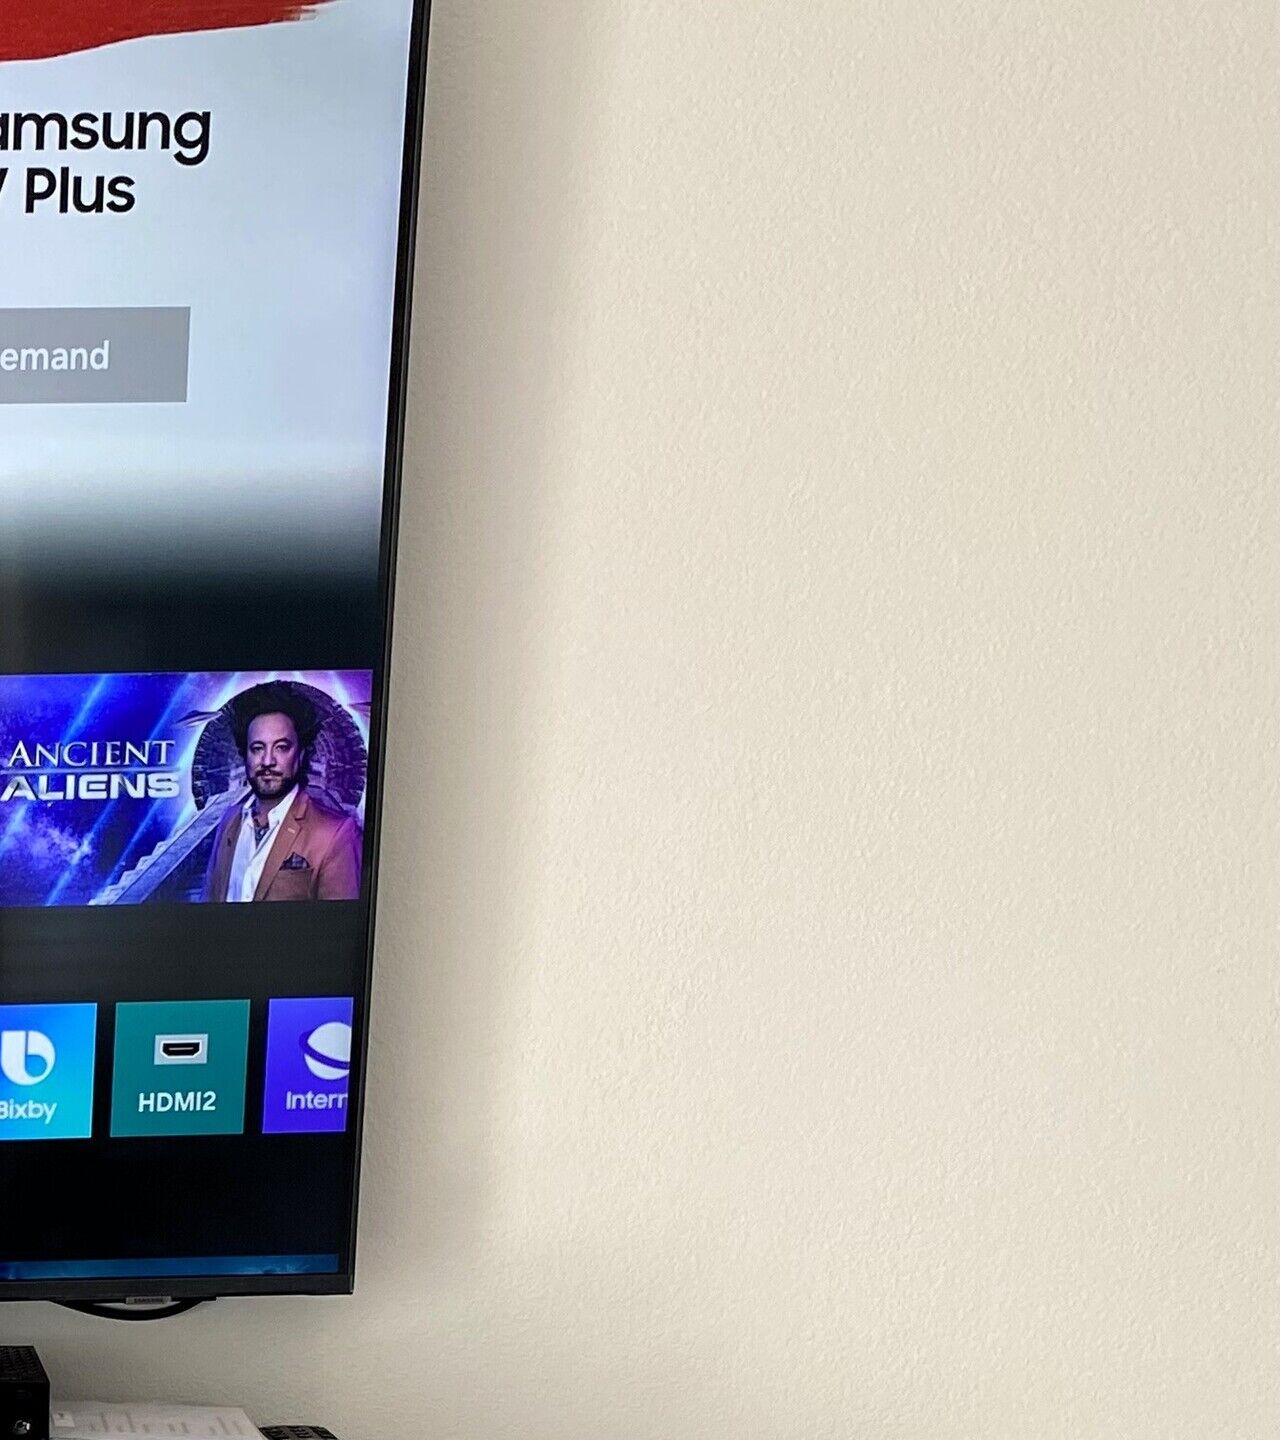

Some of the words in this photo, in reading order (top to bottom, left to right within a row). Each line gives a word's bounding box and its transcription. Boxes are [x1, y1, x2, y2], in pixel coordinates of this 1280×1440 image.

[25, 167, 135, 214] Plus
[7, 739, 176, 768] ANCIENT
[0, 772, 180, 801] ALIENS
[138, 1091, 216, 1114] HDMI2
